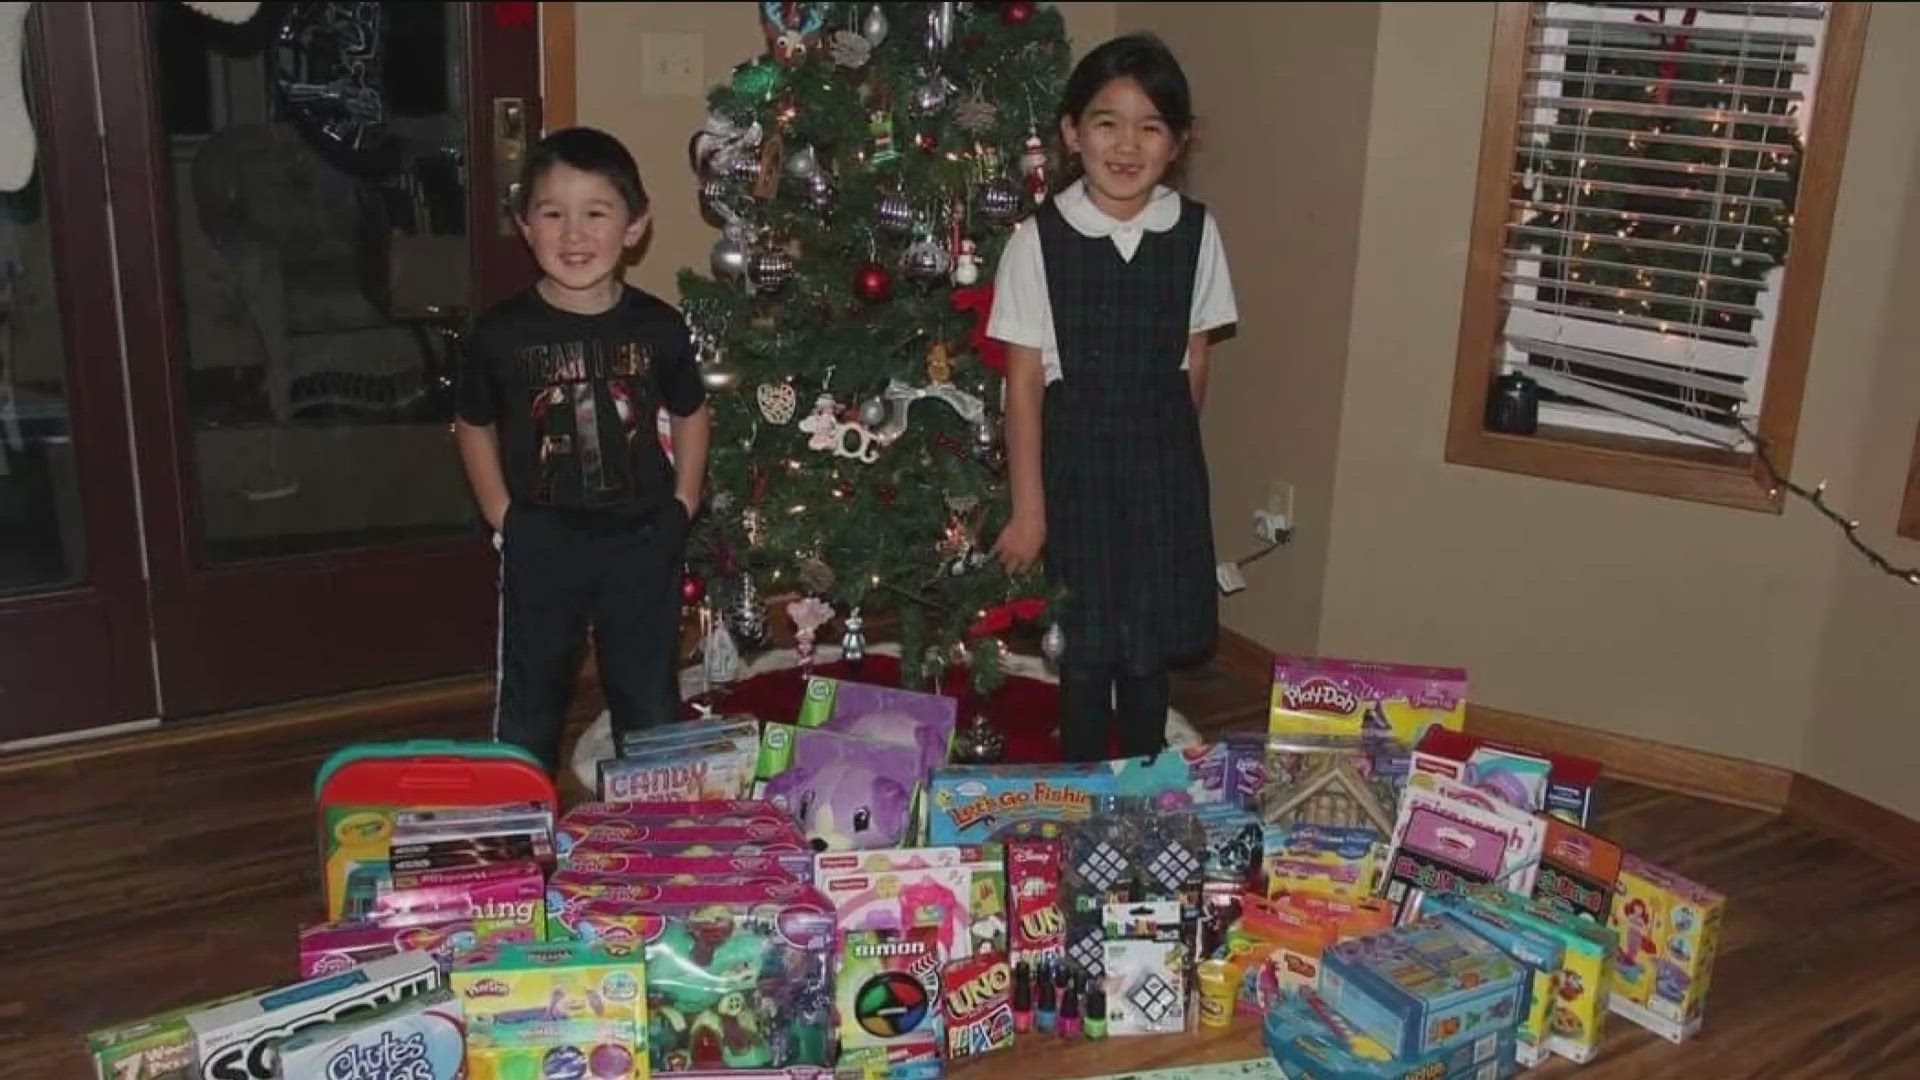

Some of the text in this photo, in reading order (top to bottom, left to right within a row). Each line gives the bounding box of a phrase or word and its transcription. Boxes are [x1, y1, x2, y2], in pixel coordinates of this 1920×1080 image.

[610, 760, 708, 799] CANDY
[1001, 791, 1029, 808] Go
[1021, 903, 1066, 940] UN
[949, 962, 1011, 1017] UNO
[327, 1031, 427, 1080] Chutes
